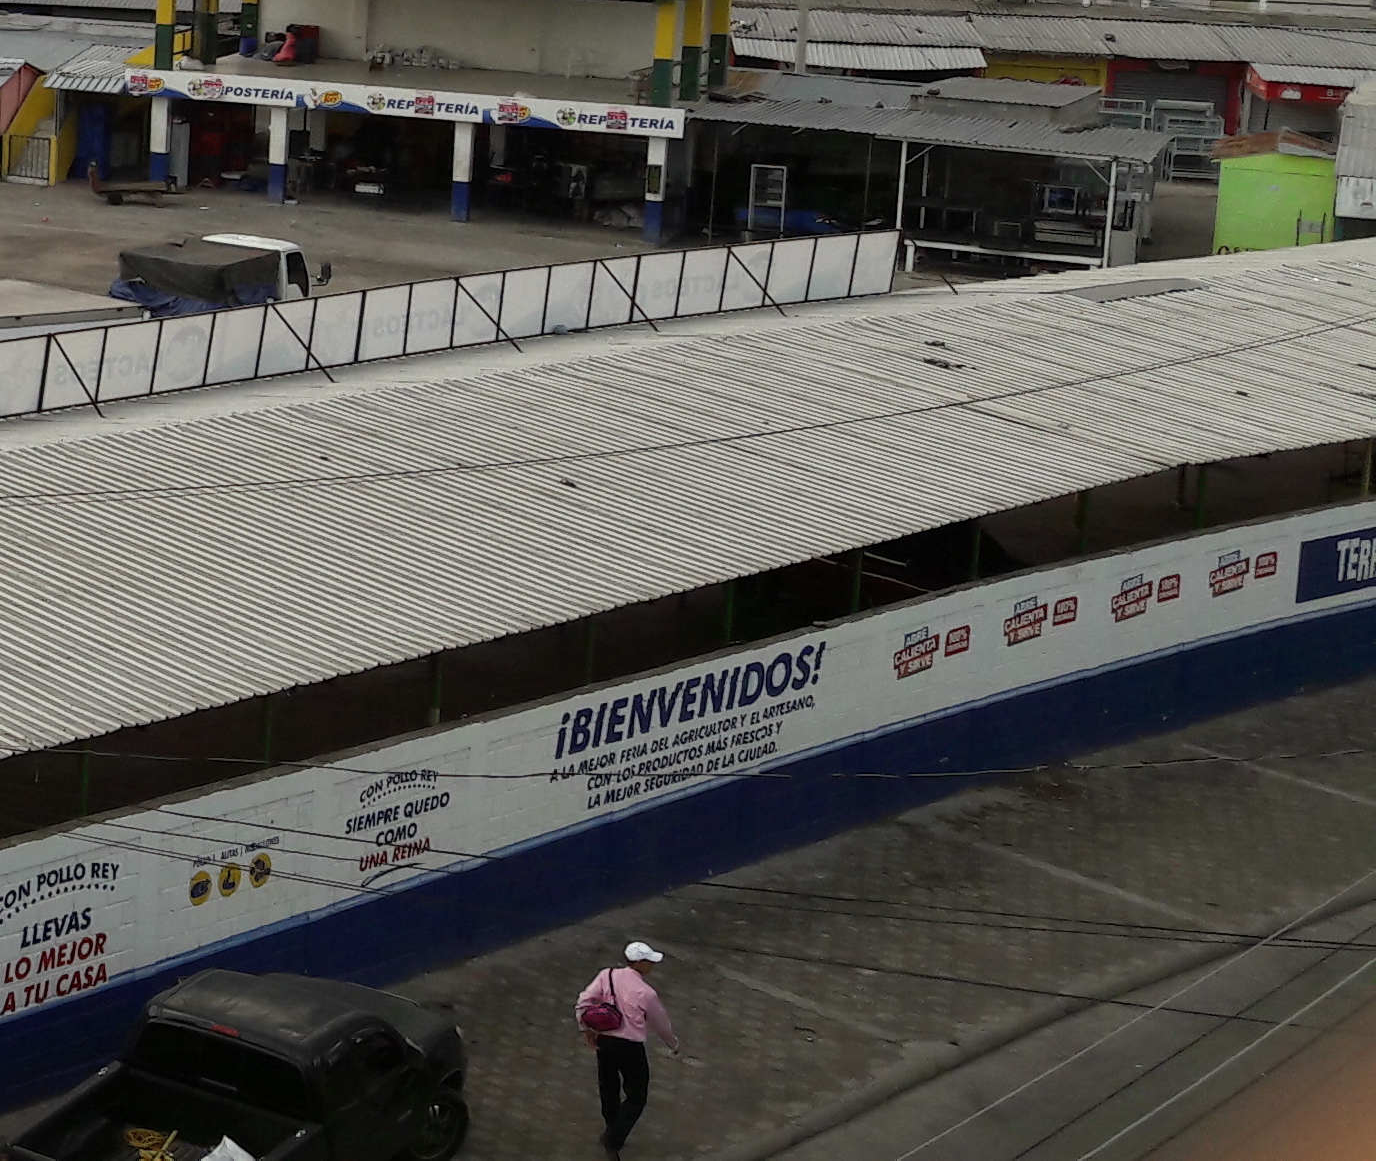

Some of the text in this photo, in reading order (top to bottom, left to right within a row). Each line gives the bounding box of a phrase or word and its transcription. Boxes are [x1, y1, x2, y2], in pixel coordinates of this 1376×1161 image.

[895, 638, 937, 666] CALIENTA
[554, 641, 826, 759] ¡BIENVENIDOS!
[562, 765, 576, 780] LA
[578, 753, 616, 776] MEJOR
[620, 745, 648, 765] FERIA
[650, 738, 669, 754] DEL
[672, 717, 738, 747] AGRICULTOR
[739, 714, 747, 728] Y
[750, 712, 761, 726] EL
[763, 694, 816, 722] ARTESANO,
[587, 773, 614, 791] CON
[616, 766, 635, 783] LOS
[635, 744, 703, 776] PRODUCTOS
[730, 725, 773, 749] FRESCOS
[774, 720, 783, 735] Y
[360, 769, 439, 803] CON POLLO REY
[587, 741, 778, 810] LA MEJOR SEGURIDAD DE LA CIUDAD.
[345, 791, 450, 834] SIEMPRE QUEDO
[359, 837, 431, 872] UNA REINA
[376, 822, 417, 847] COMO
[37, 862, 86, 892] POLLO
[91, 861, 120, 881] REY
[20, 907, 92, 949] LLEVAS
[4, 932, 107, 984] LO MEJOR
[0, 962, 107, 1016] A TU CASA
